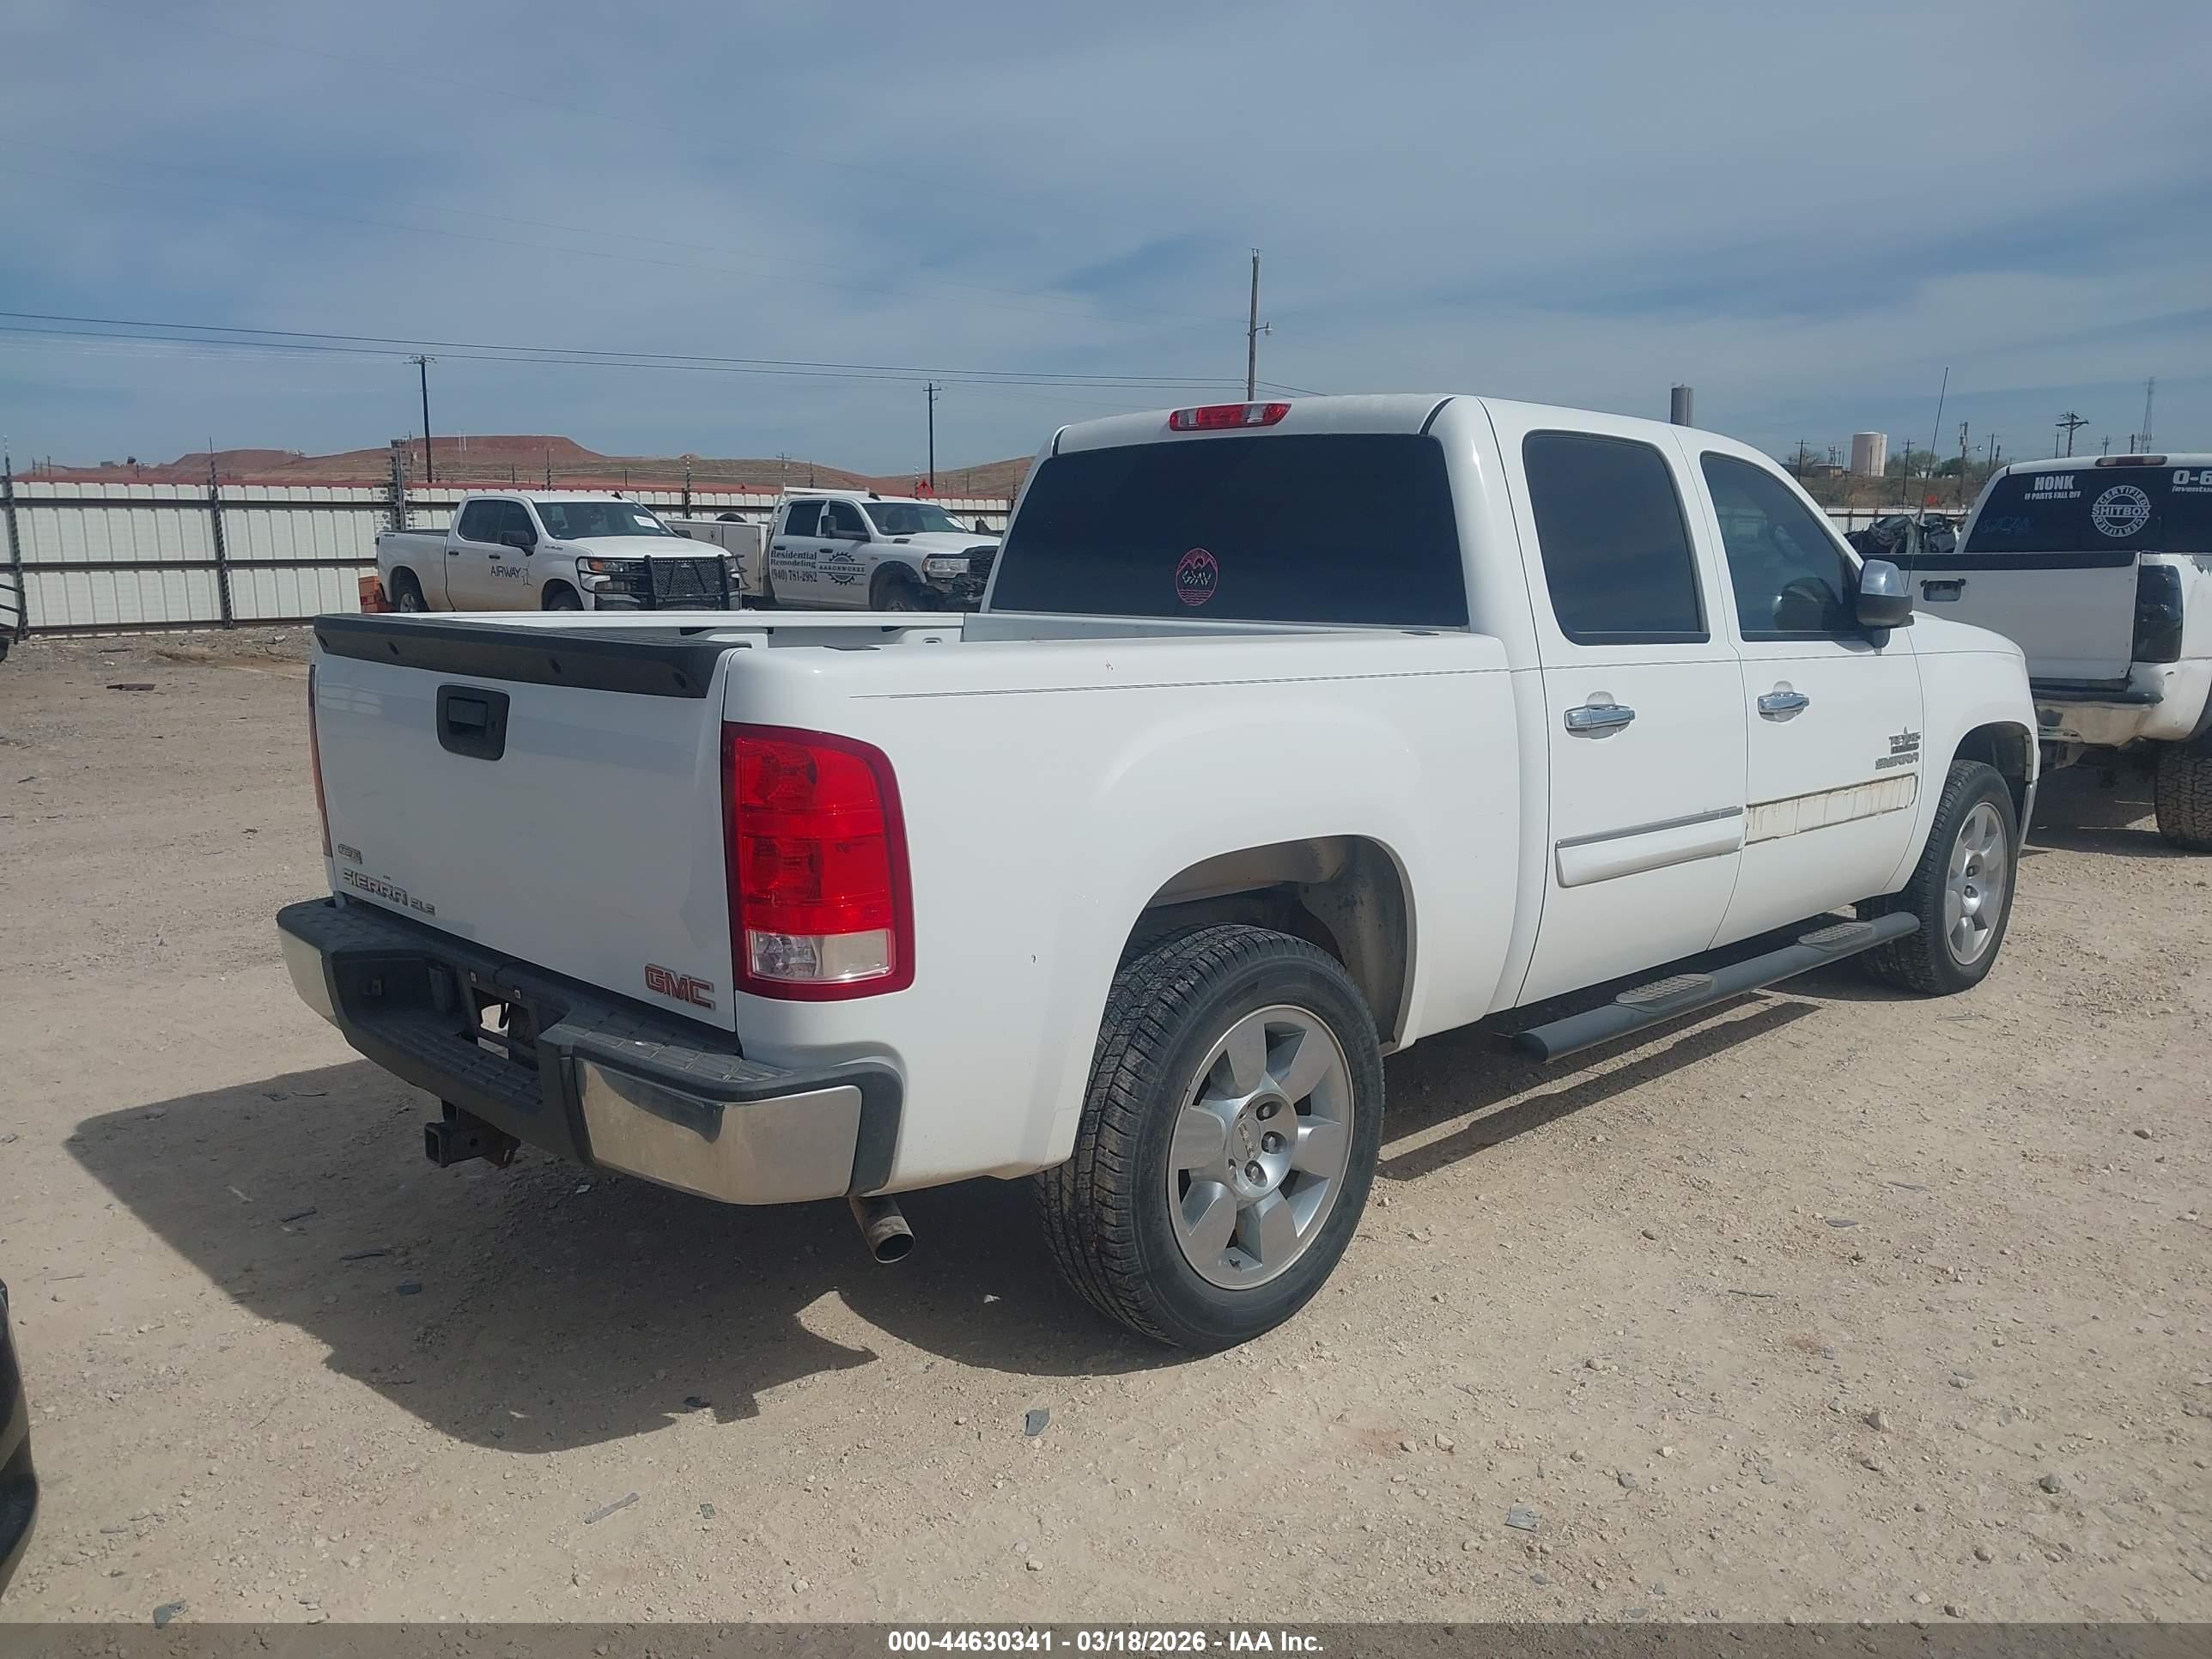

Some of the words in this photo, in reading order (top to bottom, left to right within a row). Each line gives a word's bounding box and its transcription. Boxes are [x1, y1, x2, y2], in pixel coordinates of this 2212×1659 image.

[2034, 475, 2075, 490] HONK
[2100, 487, 2147, 506] CERTIFIED
[2091, 507, 2151, 516] SHITBOX
[2095, 517, 2143, 536] CERTIFIED
[770, 550, 817, 560] Residential
[770, 559, 817, 568] Remodeling
[490, 565, 522, 578] AIRWAY
[771, 568, 787, 582] (940)
[343, 866, 408, 906] SIERRA
[645, 963, 716, 1010] GMC
